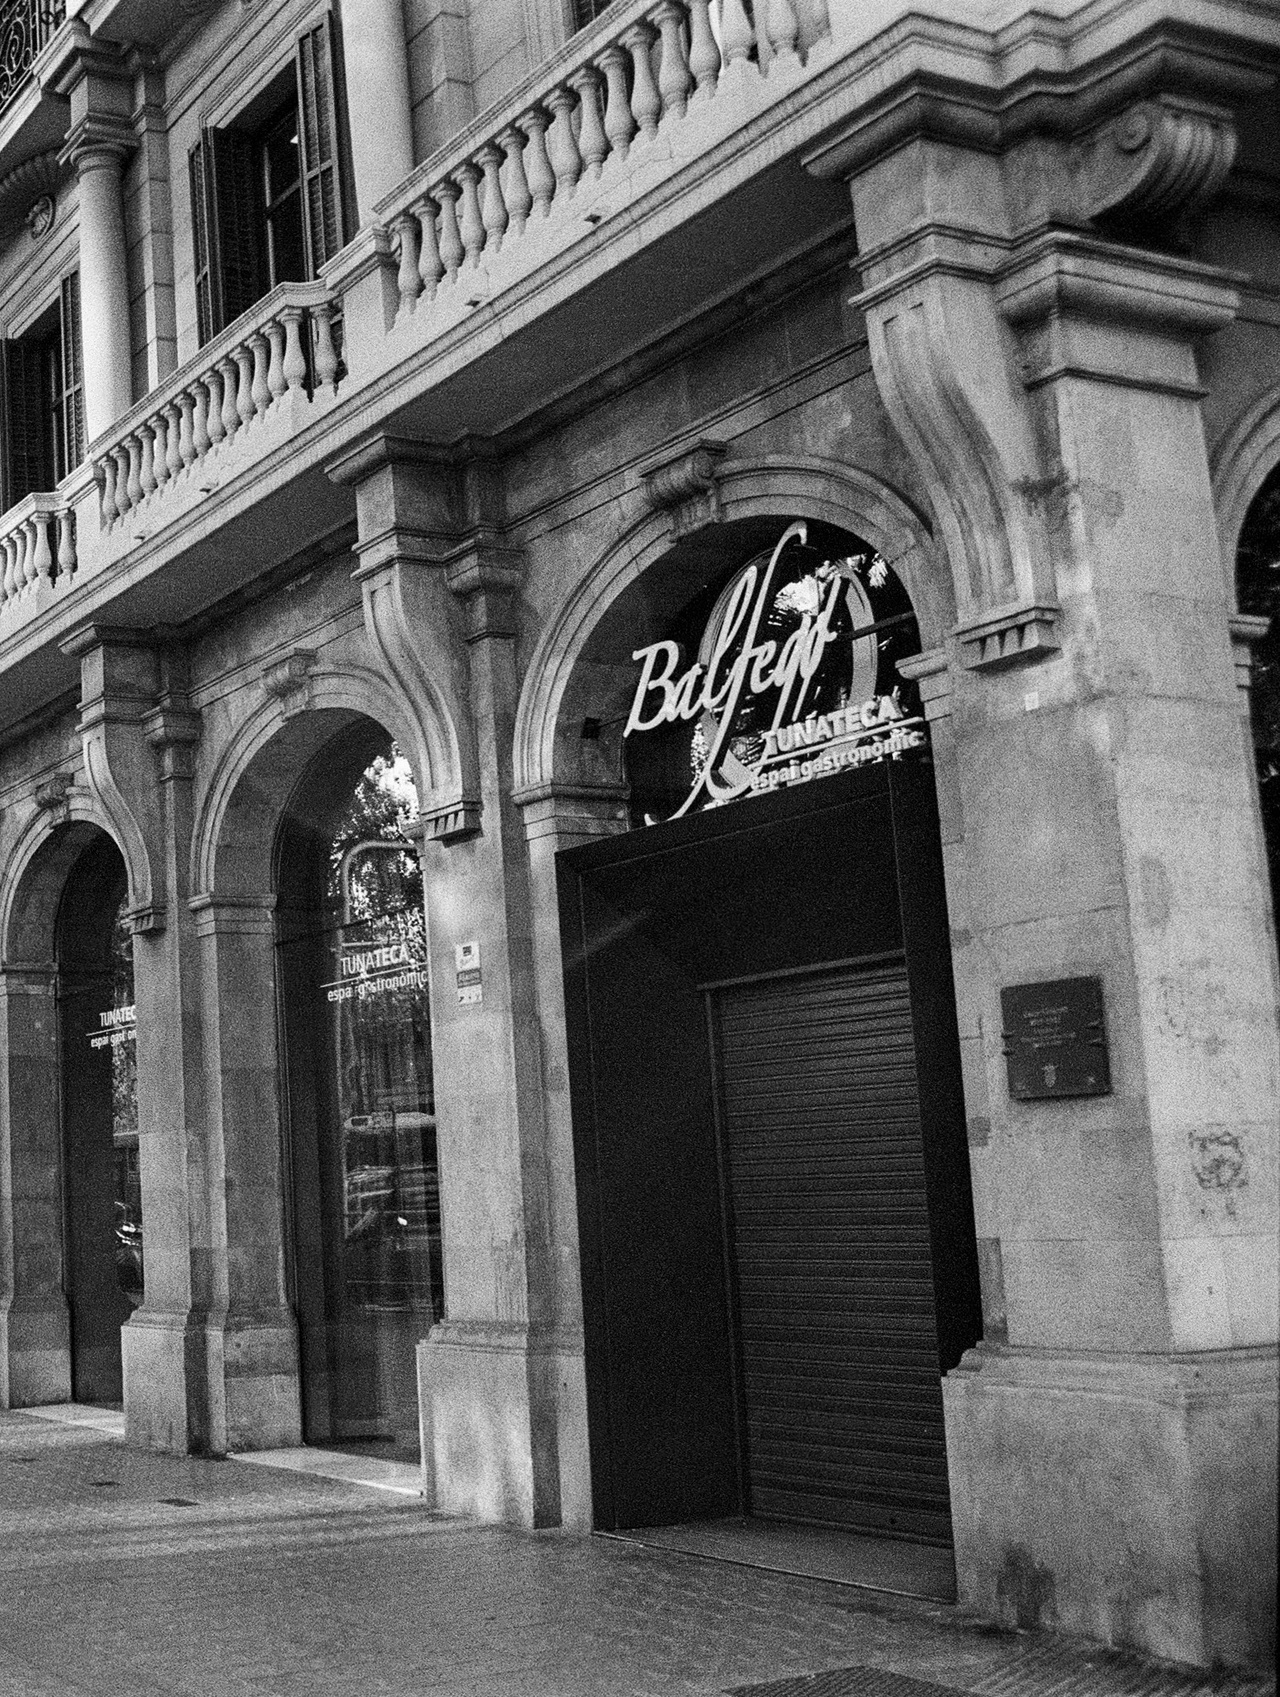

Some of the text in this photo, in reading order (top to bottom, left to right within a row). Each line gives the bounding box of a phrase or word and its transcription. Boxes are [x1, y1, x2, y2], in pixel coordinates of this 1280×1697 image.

[761, 696, 904, 756] TUNATECA
[749, 759, 801, 790] espai
[340, 942, 409, 976] TUNATECA
